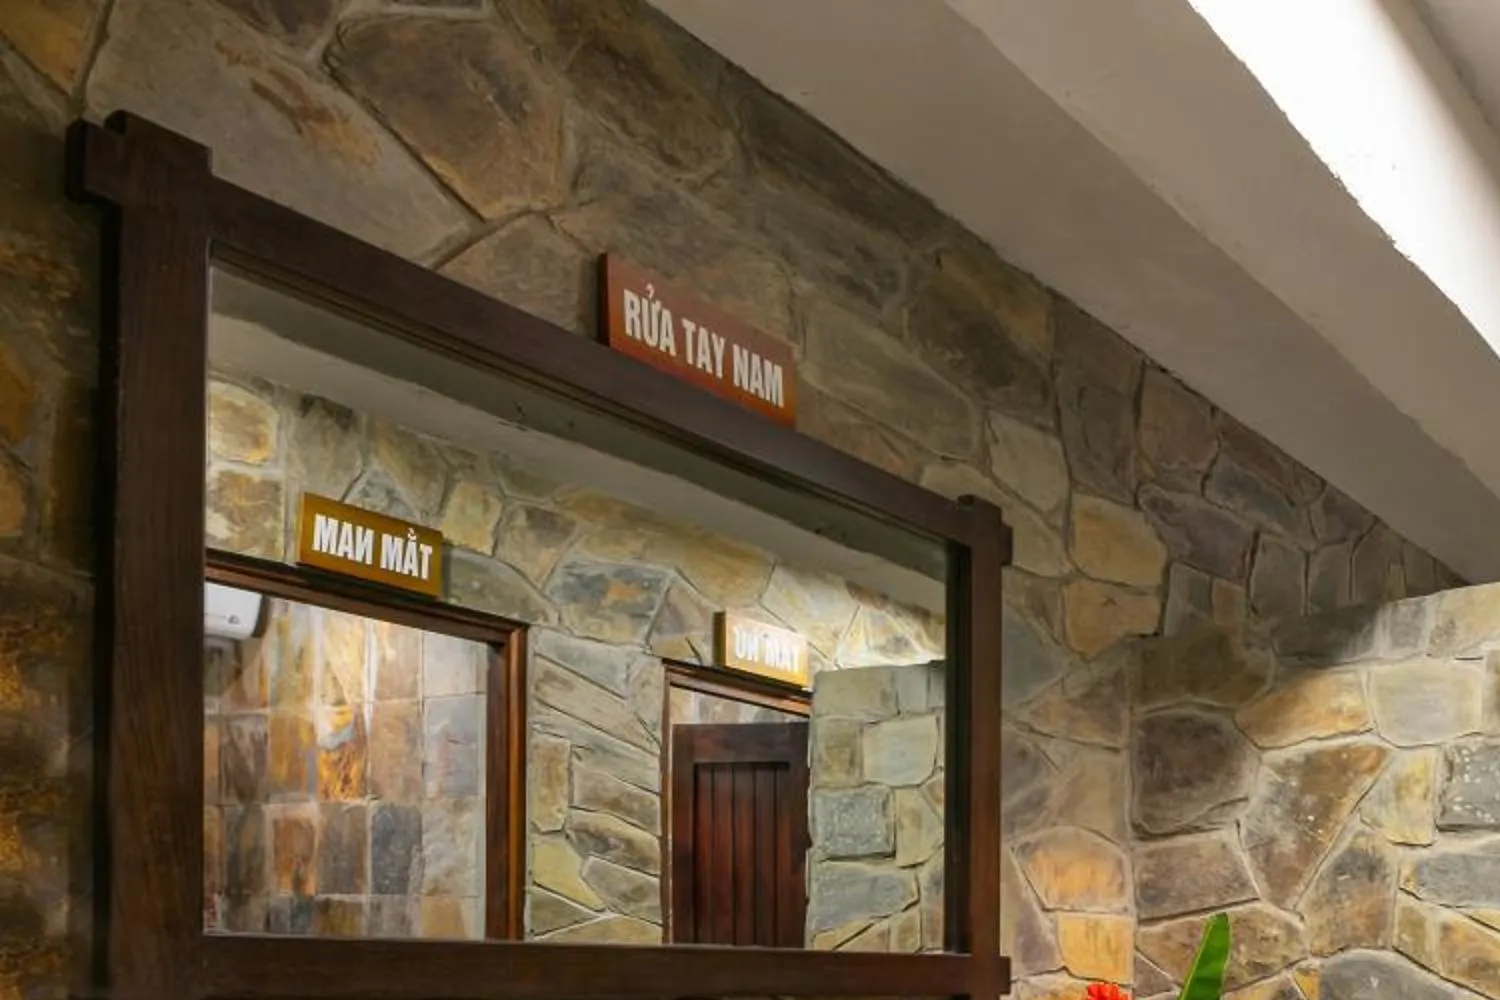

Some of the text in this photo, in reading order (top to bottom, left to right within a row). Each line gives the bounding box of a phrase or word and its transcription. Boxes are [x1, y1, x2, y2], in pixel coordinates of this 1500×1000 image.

[623, 282, 784, 408] RỬA TAY NAM
